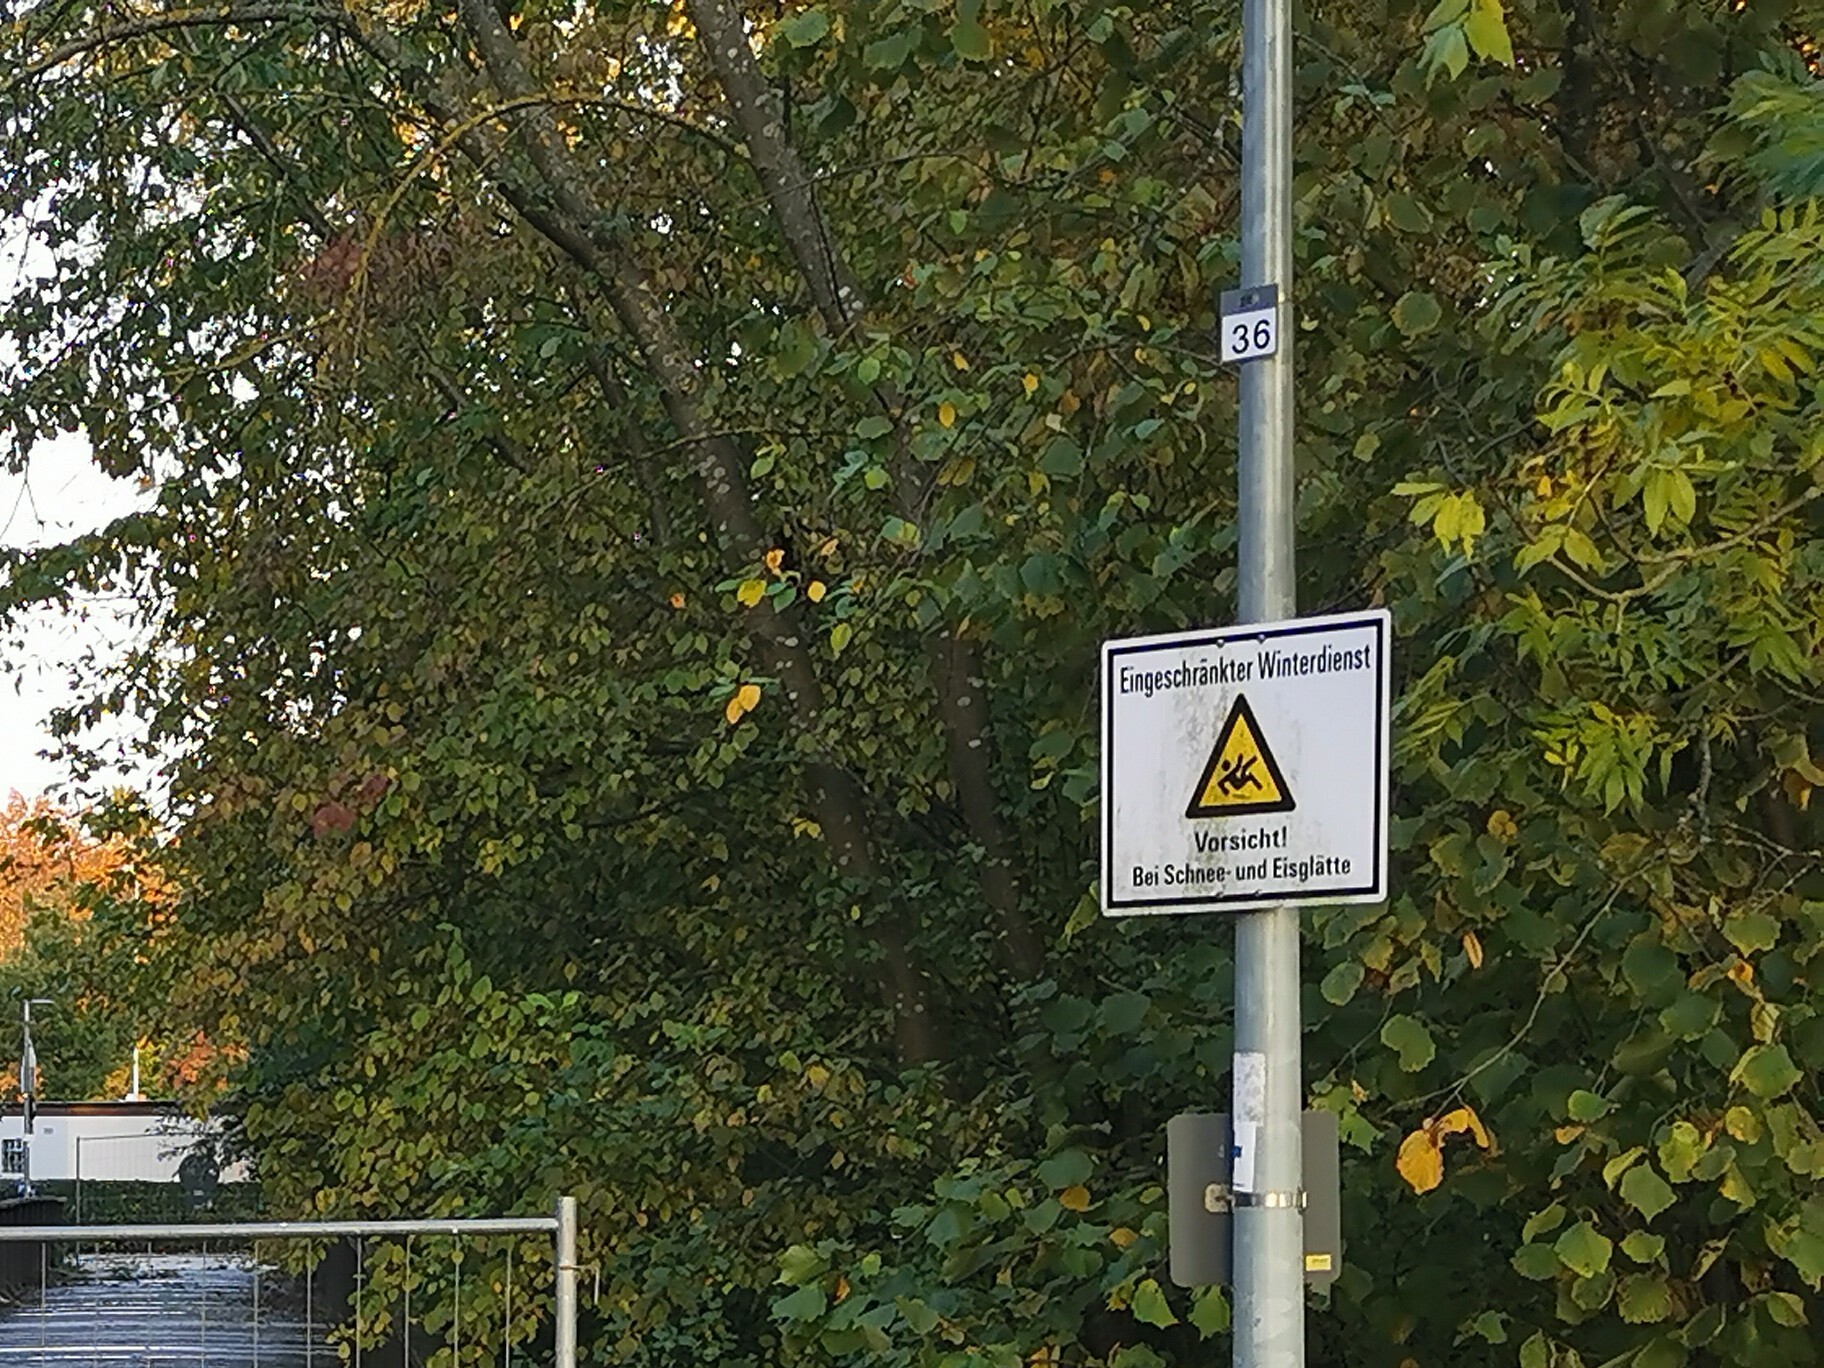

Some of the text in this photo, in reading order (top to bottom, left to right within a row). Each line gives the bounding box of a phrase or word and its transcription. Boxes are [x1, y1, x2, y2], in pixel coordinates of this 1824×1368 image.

[1232, 319, 1271, 354] 36
[1119, 643, 1372, 698] Eingeschränkter Winterdienst
[1194, 826, 1288, 853] Vorsicht!
[1132, 855, 1352, 888] Bei Schnee- und Eisglätte
